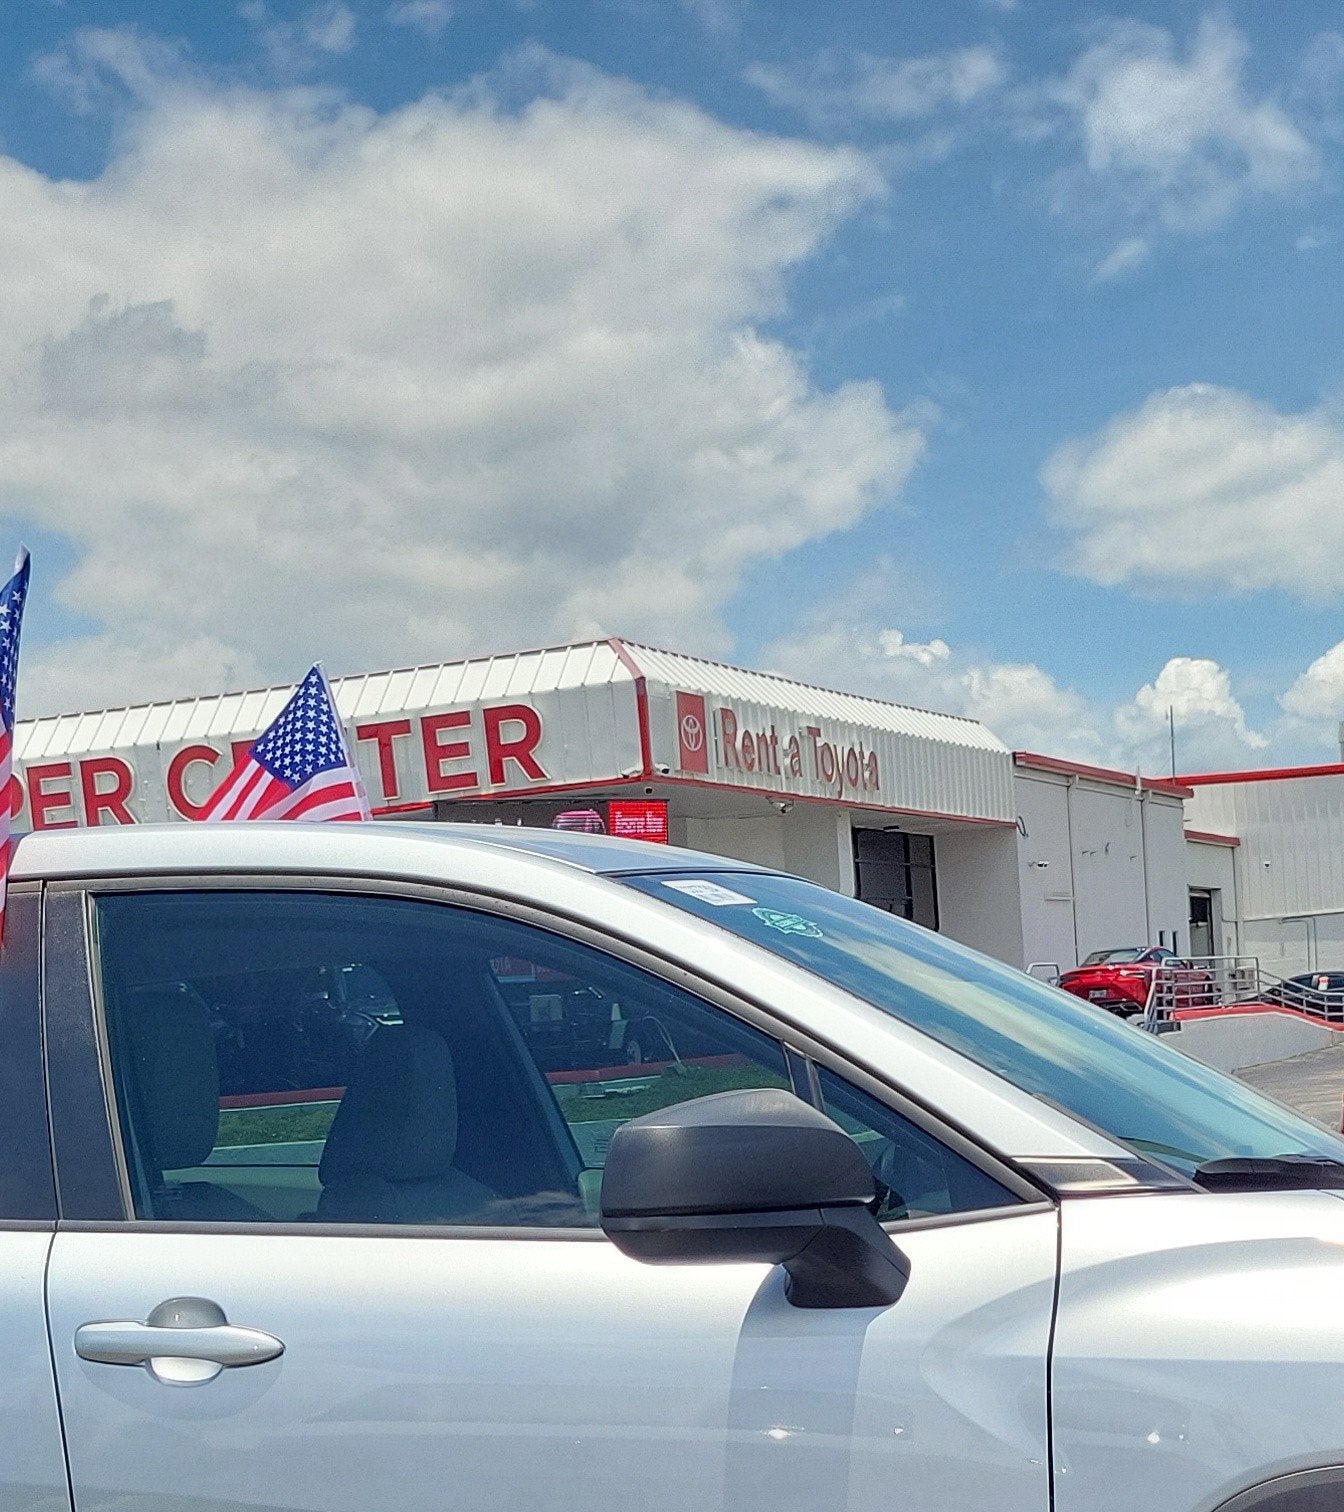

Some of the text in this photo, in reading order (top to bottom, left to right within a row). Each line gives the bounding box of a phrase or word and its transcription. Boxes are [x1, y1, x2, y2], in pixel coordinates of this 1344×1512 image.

[166, 703, 551, 821] CTER
[718, 707, 880, 799] Rent a Toyota
